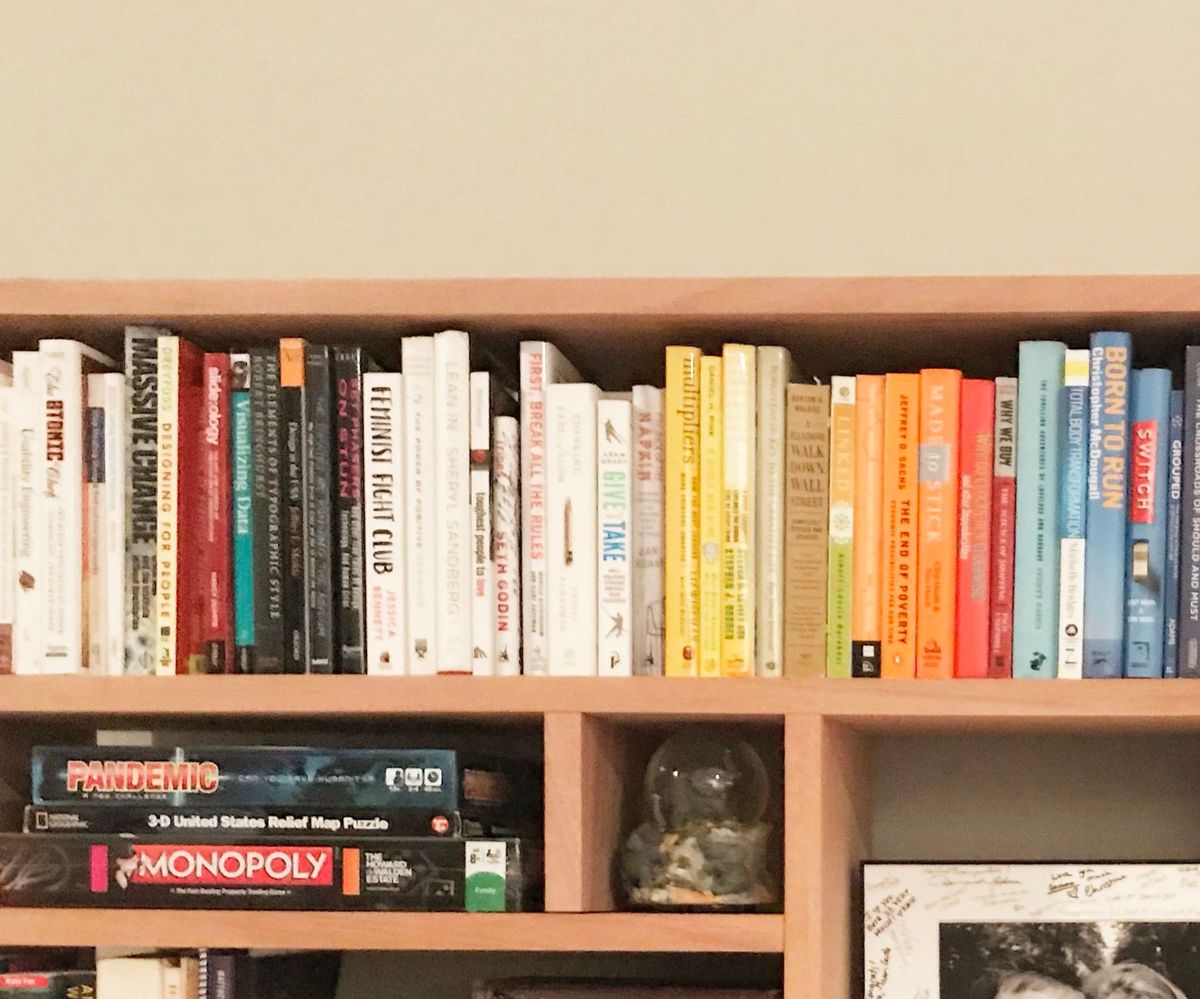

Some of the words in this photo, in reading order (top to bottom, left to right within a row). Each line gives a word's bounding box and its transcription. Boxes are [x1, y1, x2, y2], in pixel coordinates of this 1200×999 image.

[131, 337, 158, 444] MASSIVE
[445, 361, 459, 407] LEAN
[1069, 387, 1082, 417] TOTAL
[1089, 347, 1104, 426] Christopher
[1104, 346, 1127, 415] BORN
[370, 386, 393, 465] FEMINIST
[445, 412, 459, 431] IN
[677, 355, 698, 464] multipliers
[926, 383, 943, 444] MADE
[999, 400, 1013, 424] WHY
[1069, 418, 1082, 445] BODY
[233, 400, 250, 491] Visualizing
[835, 415, 849, 492] LINKED
[999, 427, 1012, 444] WE
[999, 446, 1012, 467] BUY
[1104, 420, 1127, 450] TO
[160, 423, 173, 513] DESIGNING
[445, 447, 459, 511] SHERYL
[926, 453, 941, 473] to
[1088, 428, 1101, 500] McDougall
[1102, 456, 1126, 509] RUN
[1134, 428, 1154, 511] SWITCH
[1170, 439, 1182, 500] GROUPED
[131, 450, 158, 545] CHANGE
[371, 473, 394, 523] FIGHT
[602, 471, 625, 510] GIVE
[898, 499, 910, 528] THE
[926, 480, 943, 543] STICK
[1067, 447, 1081, 538] TRANSFORMATION
[160, 522, 173, 552] FOR
[235, 496, 251, 535] Data
[371, 529, 393, 575] CLUB
[495, 531, 509, 575] SETH
[603, 520, 626, 562] TAKE
[898, 532, 910, 558] END
[160, 561, 172, 618] PEOPLE
[445, 520, 460, 617] SANDBERG
[898, 564, 909, 580] OF
[1190, 565, 1200, 589] AND
[496, 580, 509, 632] GODIN
[897, 584, 909, 646] POVERTY
[1189, 592, 1200, 622] MUST
[66, 760, 219, 794] PANDEMIC
[148, 815, 171, 828] 3-D
[174, 814, 218, 828] United
[220, 815, 265, 829] States
[268, 815, 309, 829] Relief
[311, 816, 340, 832] Map
[343, 816, 389, 830] Puzzle
[138, 850, 328, 880] MONOPOLY
